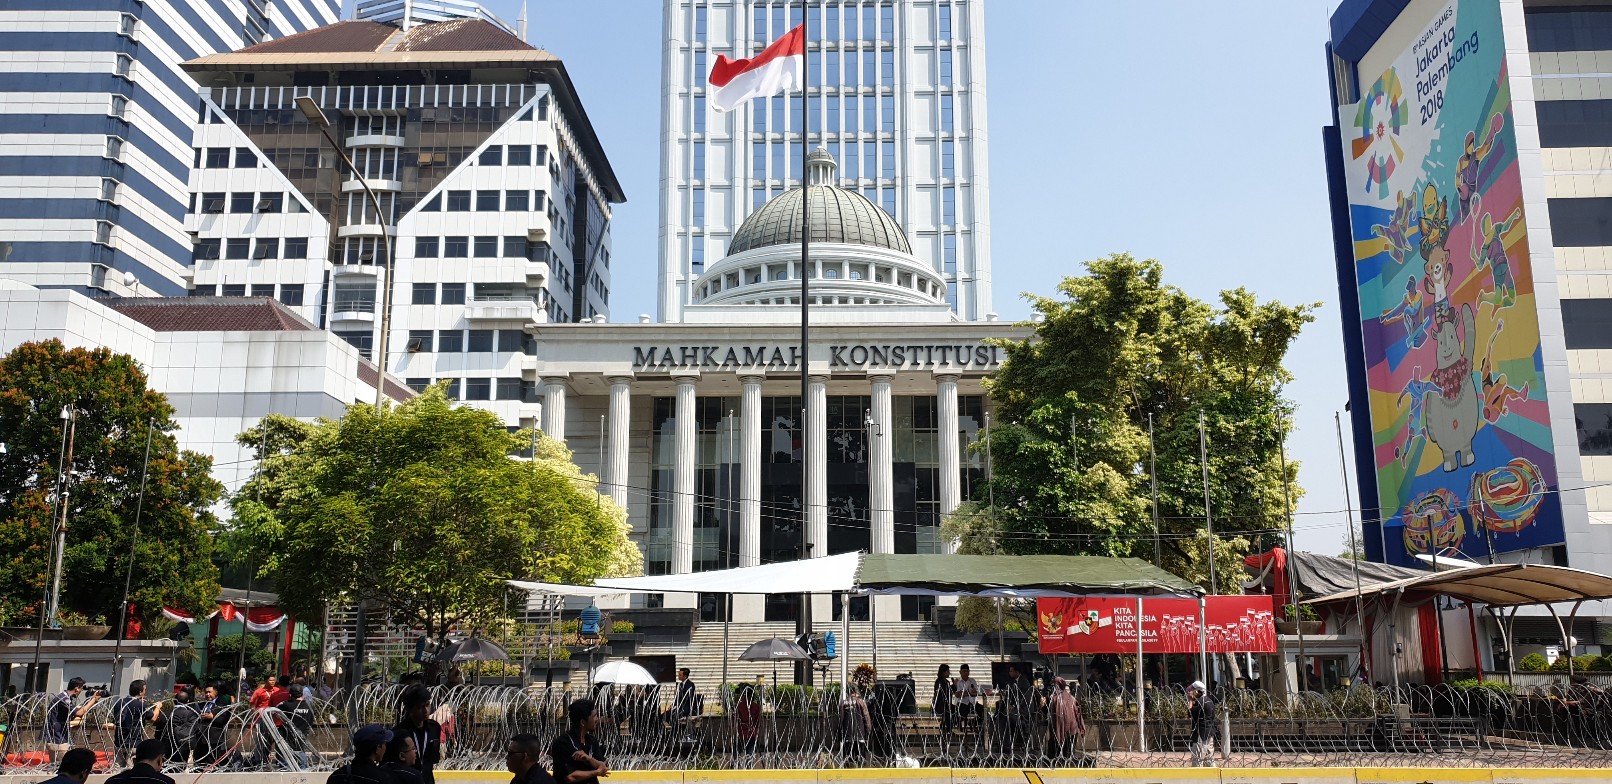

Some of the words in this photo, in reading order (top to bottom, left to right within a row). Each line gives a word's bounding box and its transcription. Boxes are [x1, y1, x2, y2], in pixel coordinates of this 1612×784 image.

[1434, 6, 1453, 31] GAMES
[1415, 26, 1456, 78] Jakarta
[1416, 30, 1480, 102] Palembang
[1420, 89, 1445, 126] 2018
[830, 344, 1000, 366] KONSTITUSI
[1113, 607, 1132, 615] KITA
[1115, 629, 1158, 637] PANCSILA
